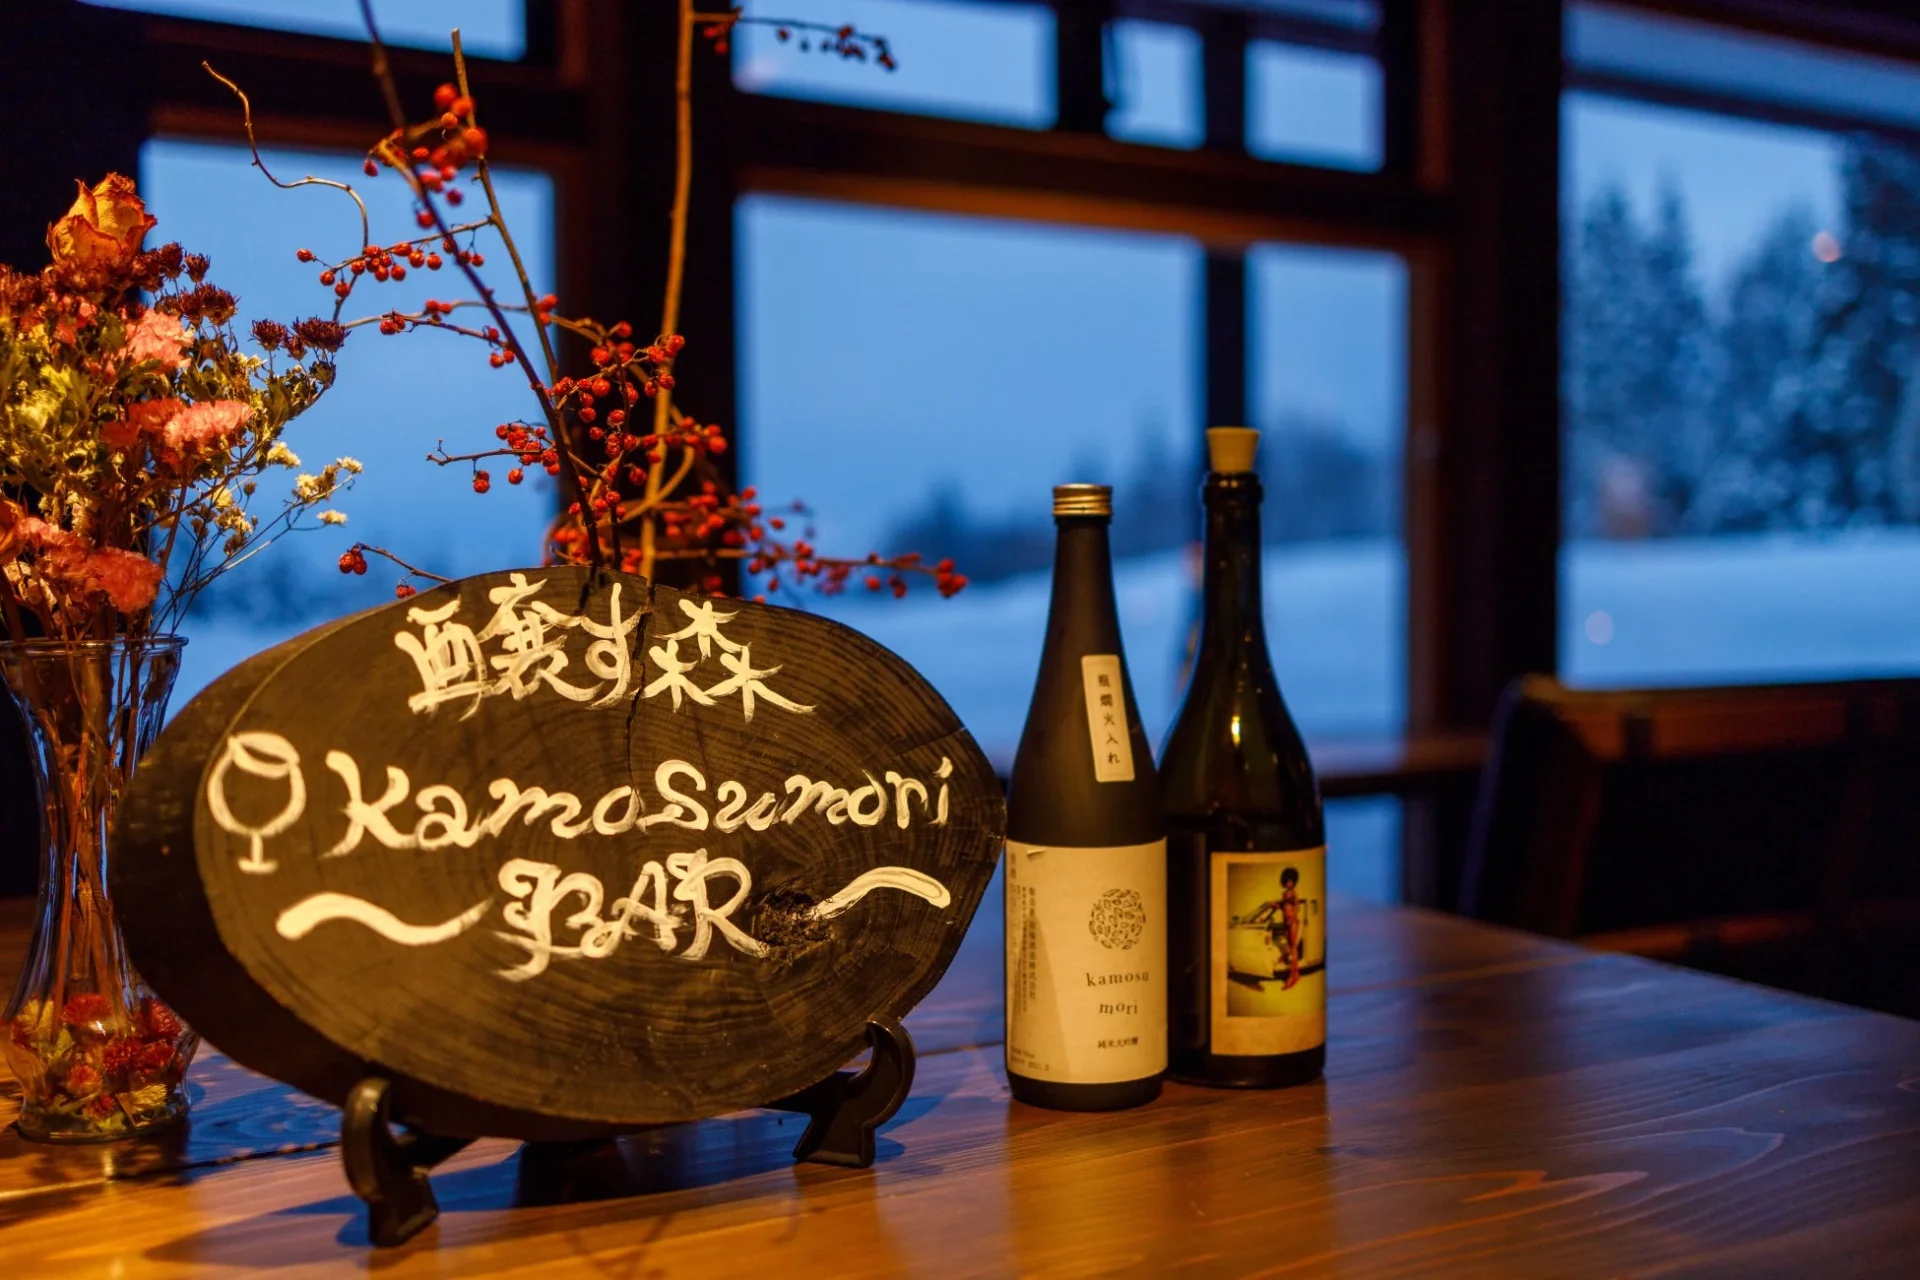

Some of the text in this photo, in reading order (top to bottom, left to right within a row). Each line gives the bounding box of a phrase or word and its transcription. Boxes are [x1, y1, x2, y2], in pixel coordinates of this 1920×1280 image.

[494, 848, 771, 982] BAR
[1086, 971, 1150, 988] kamosu
[1099, 998, 1139, 1015] mori
